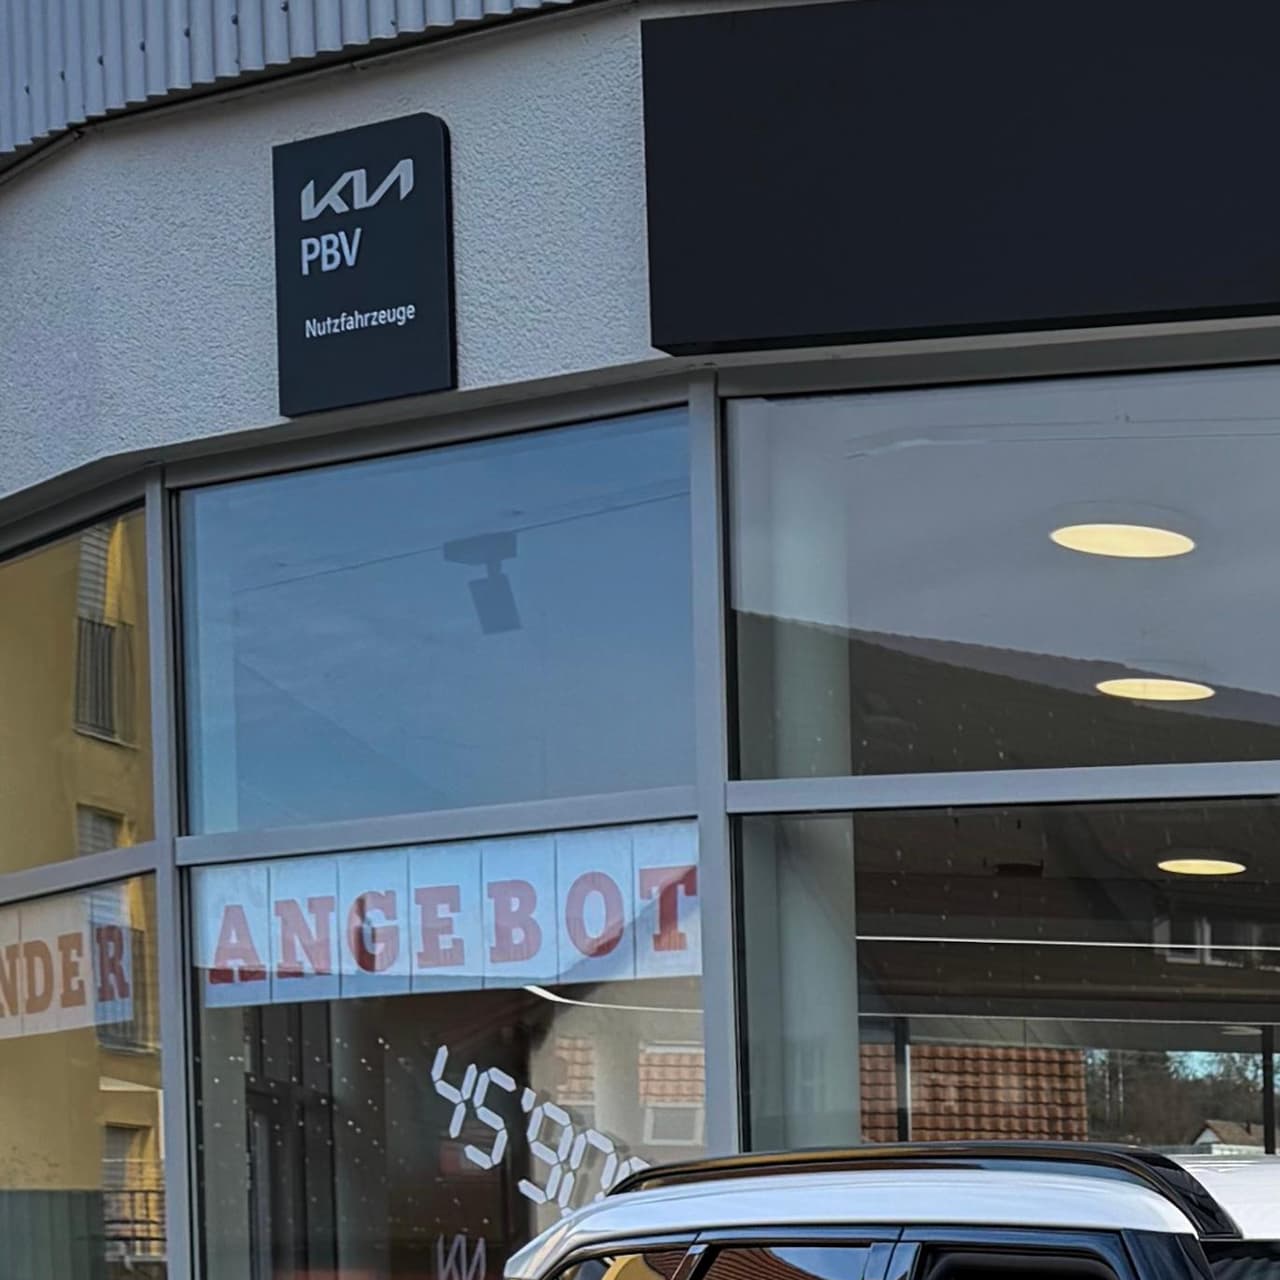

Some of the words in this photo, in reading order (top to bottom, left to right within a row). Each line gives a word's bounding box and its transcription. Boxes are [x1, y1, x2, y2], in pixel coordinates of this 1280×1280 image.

[301, 158, 414, 221] KIA
[301, 227, 362, 276] PBV
[305, 304, 416, 339] Nutzfahrzeuge
[208, 864, 697, 986] ANGEBOT
